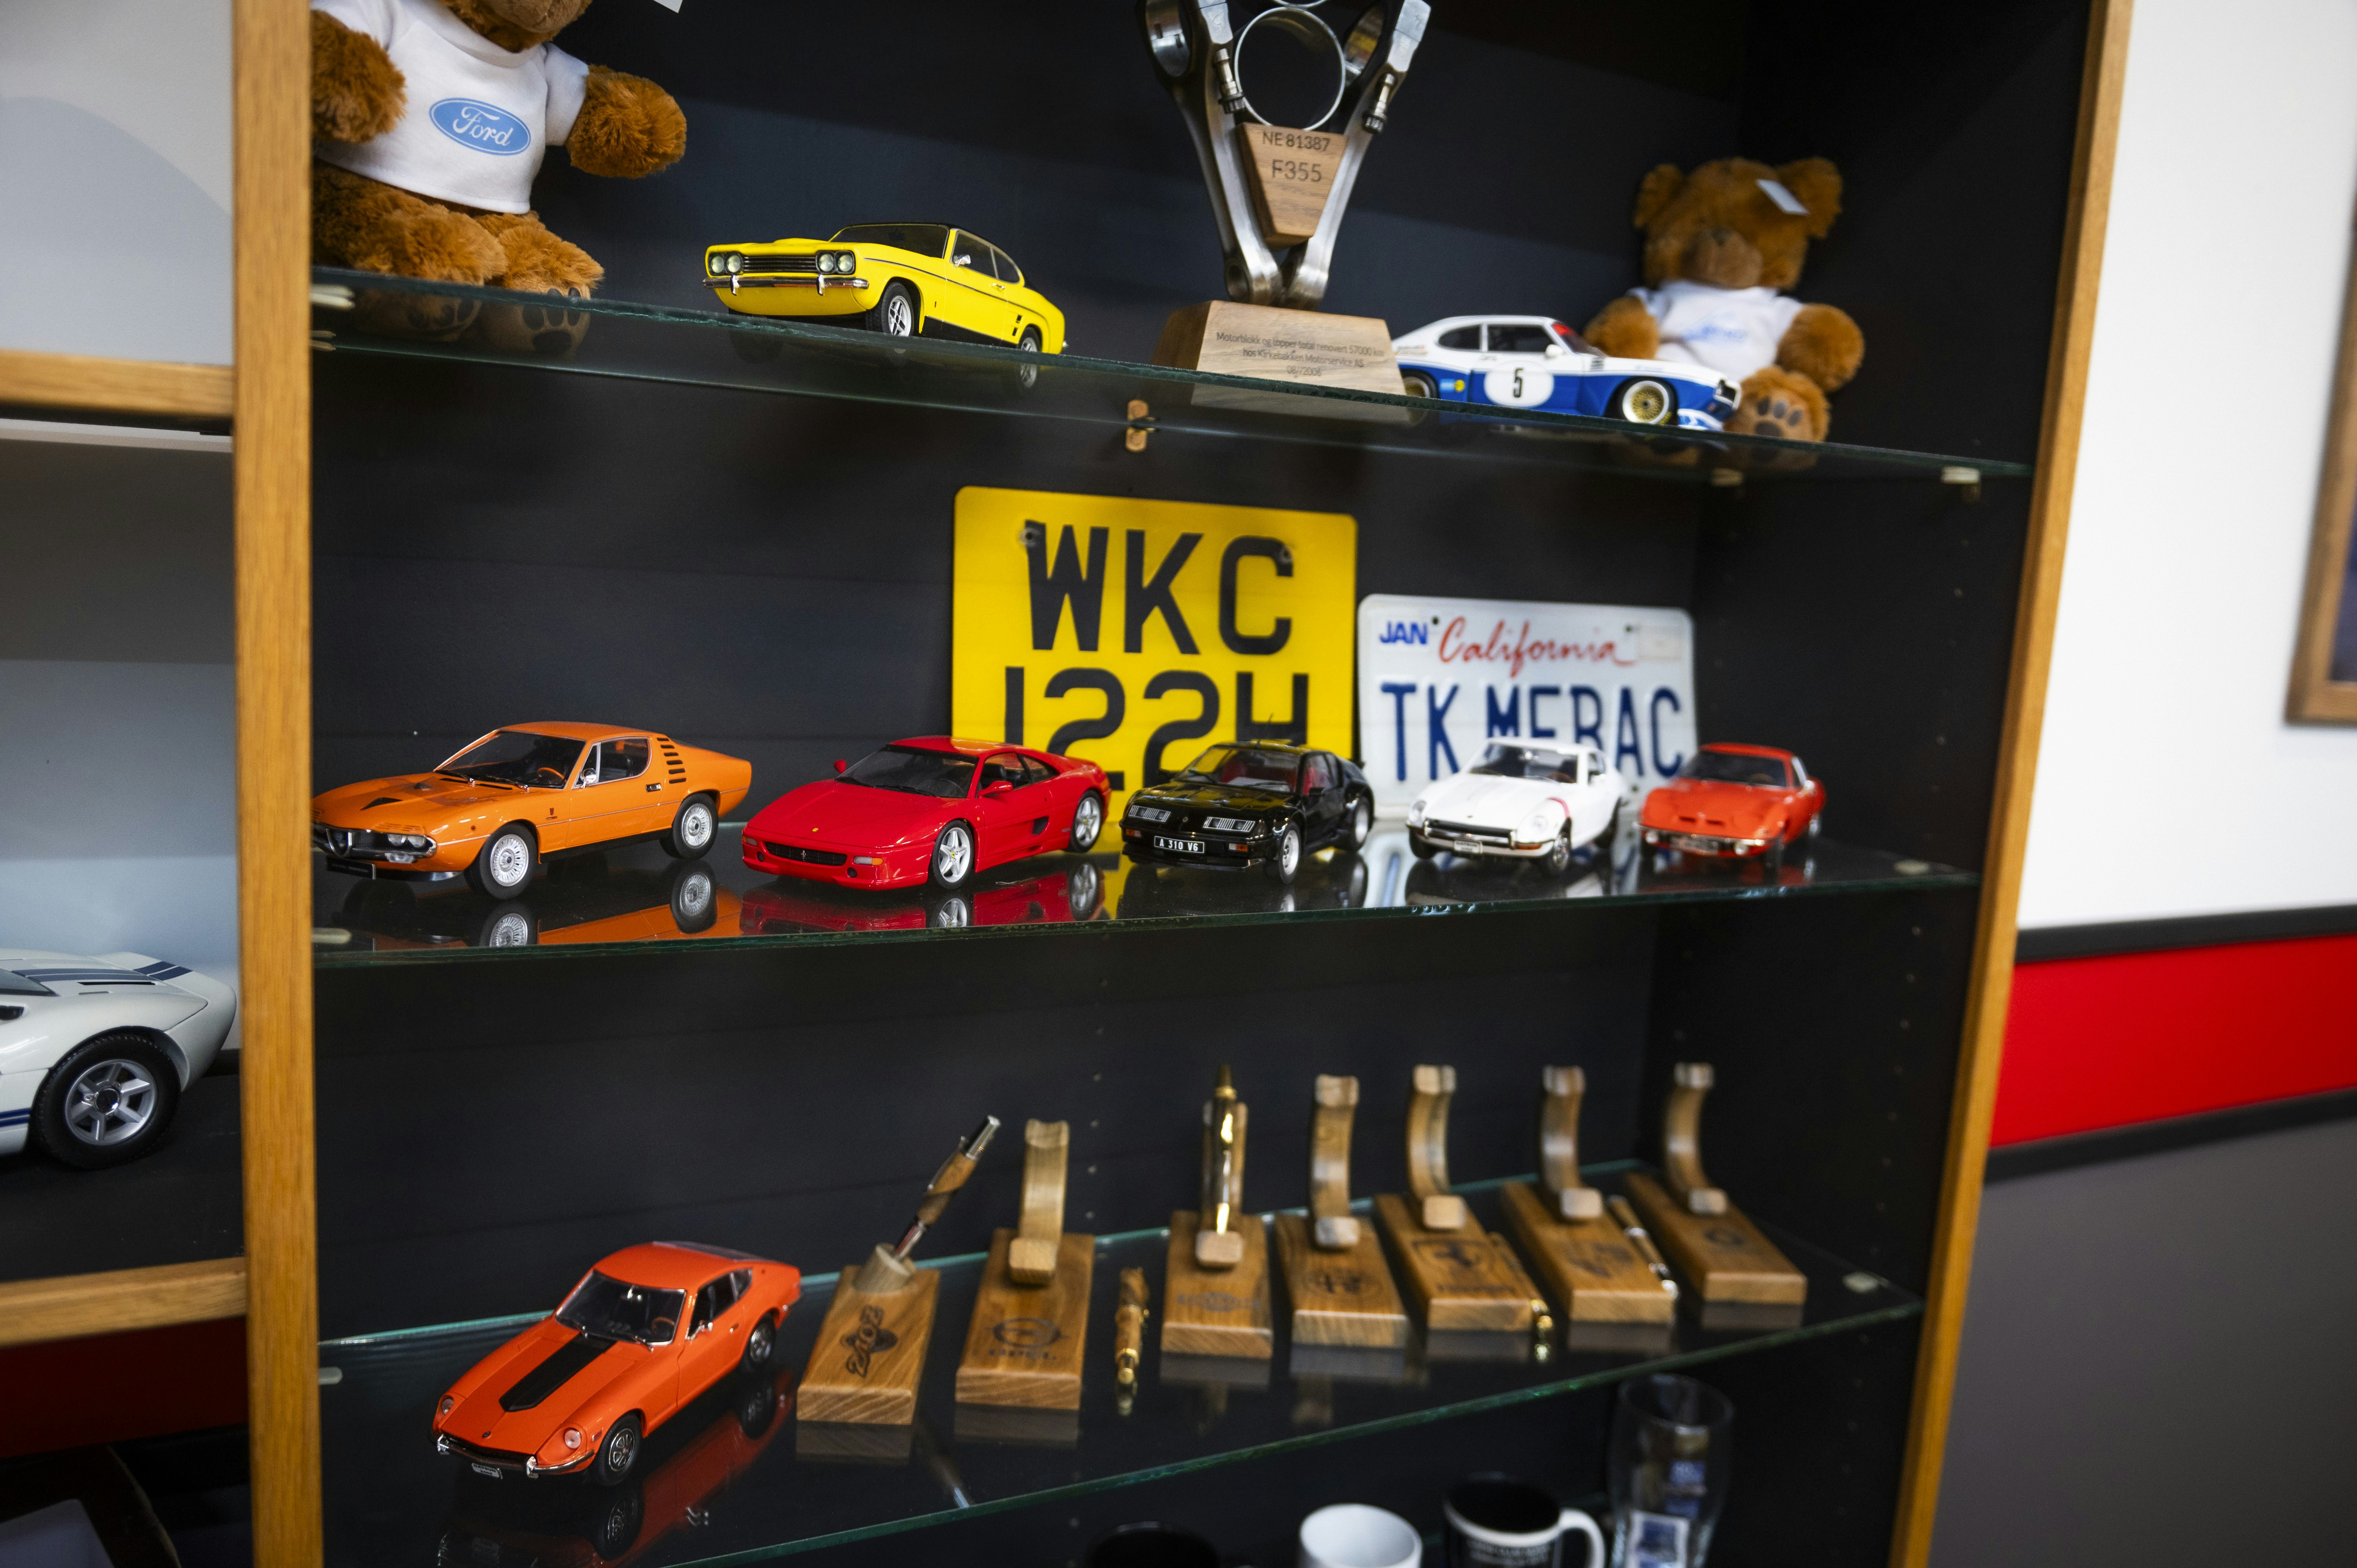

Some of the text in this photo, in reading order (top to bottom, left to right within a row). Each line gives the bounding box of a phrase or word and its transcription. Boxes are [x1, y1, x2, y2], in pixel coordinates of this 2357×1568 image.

[452, 106, 514, 146] Ford
[1272, 159, 1322, 182] F355
[1216, 332, 1261, 344] Motorblokk
[1262, 338, 1271, 347] og
[1243, 347, 1256, 357] hos
[1305, 353, 1353, 366] Motorservice
[1513, 367, 1524, 398] 5
[1024, 519, 1294, 655] WKC
[1379, 616, 1636, 679] JAN California
[1380, 681, 1461, 781] TK
[1159, 838, 1198, 851] A 310 V6
